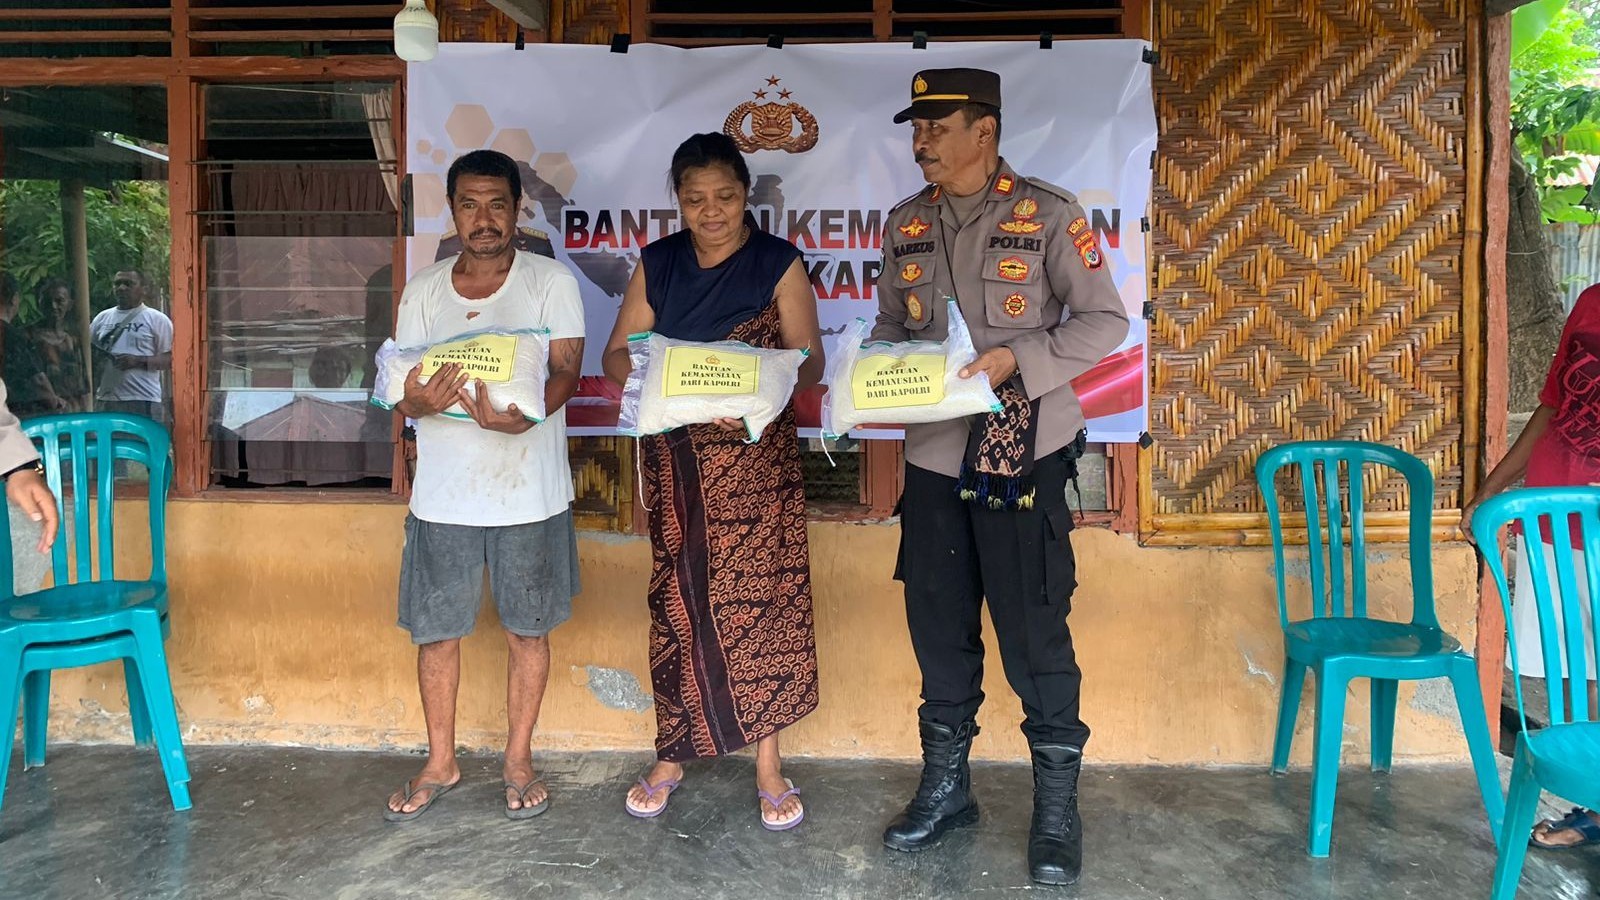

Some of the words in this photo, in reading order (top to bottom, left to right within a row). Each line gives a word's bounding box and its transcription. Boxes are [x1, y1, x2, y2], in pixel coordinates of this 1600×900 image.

[893, 241, 935, 258] MARKUS
[988, 236, 1042, 252] POLRI
[434, 354, 502, 364] KEMANUSIAAN
[461, 363, 500, 373] APOLRI
[876, 367, 919, 376] BANTUAN
[866, 375, 930, 388] KEMANUSIAAN
[866, 389, 888, 398] DARI
[891, 386, 931, 397] KAPOLRI
